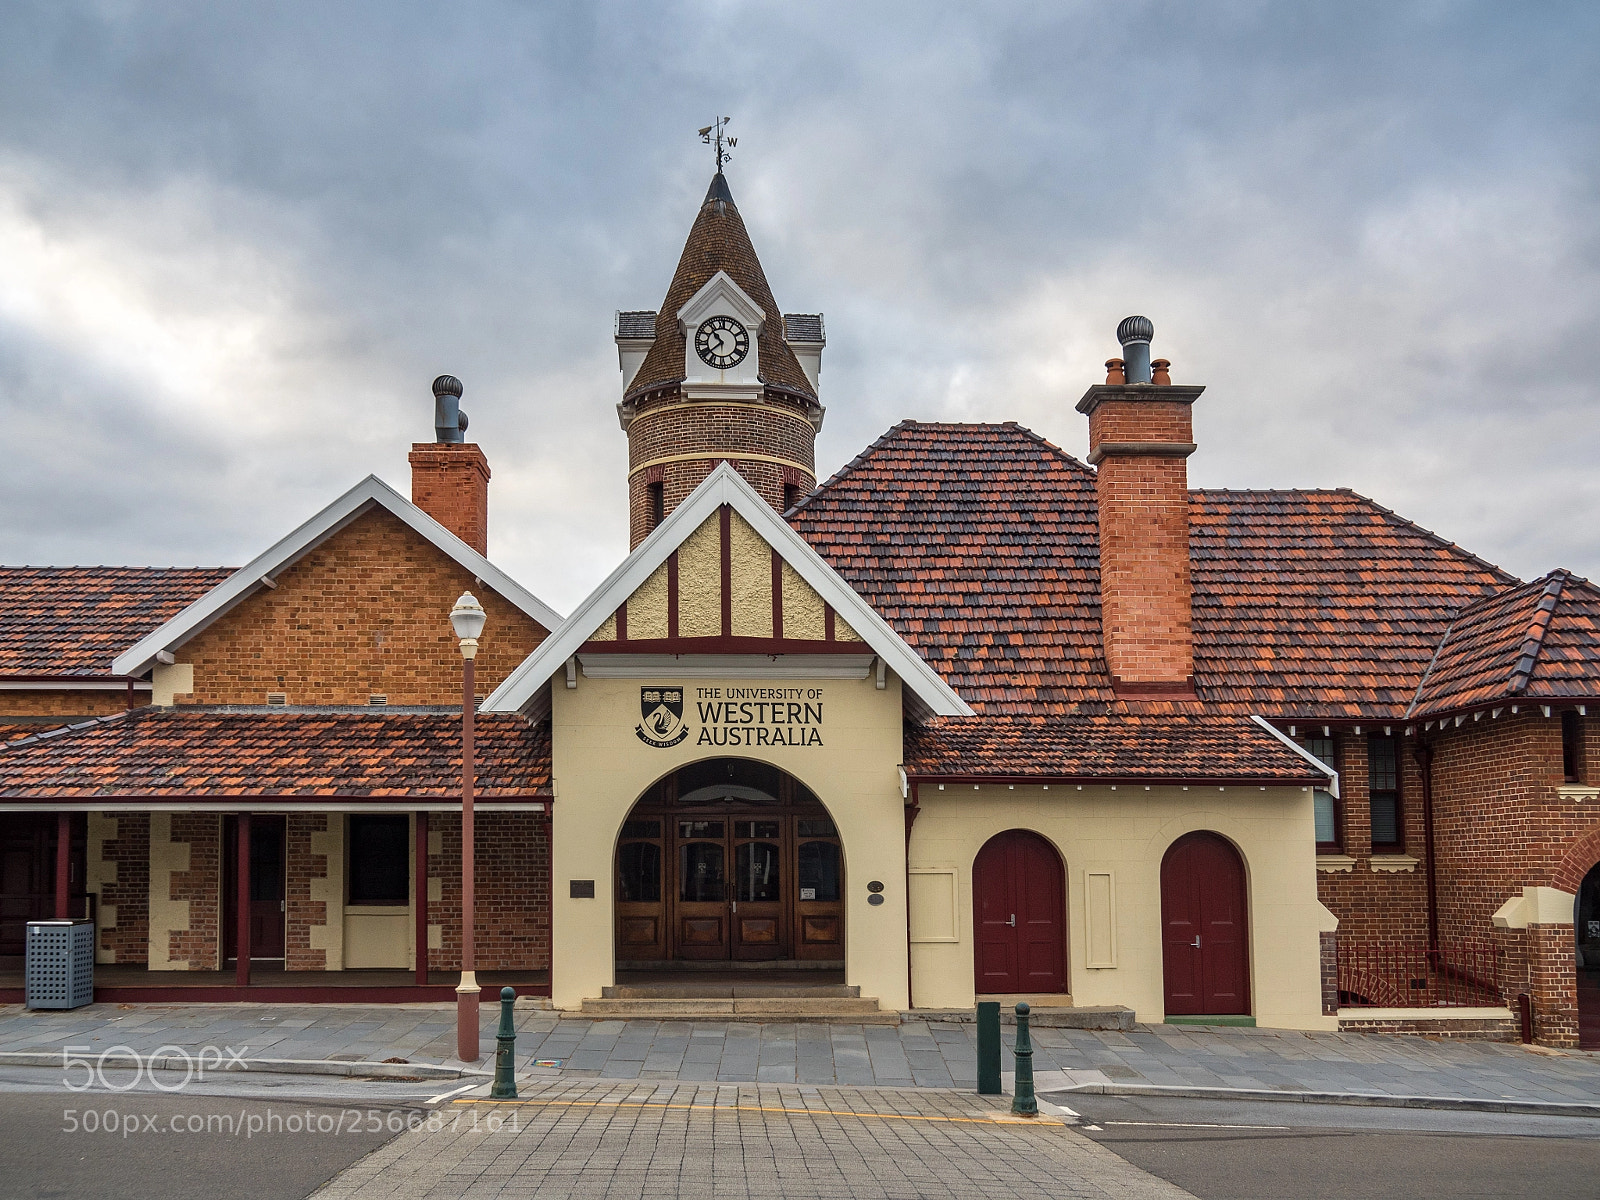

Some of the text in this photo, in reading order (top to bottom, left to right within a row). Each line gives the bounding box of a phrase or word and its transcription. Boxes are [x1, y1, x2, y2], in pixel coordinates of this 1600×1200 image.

[727, 136, 738, 147] W
[697, 688, 823, 699] THE UNIVERSITY OF
[697, 702, 823, 724] WESTERN
[642, 736, 682, 747] SEEK WISDOM
[697, 727, 823, 746] AUSTRALIA
